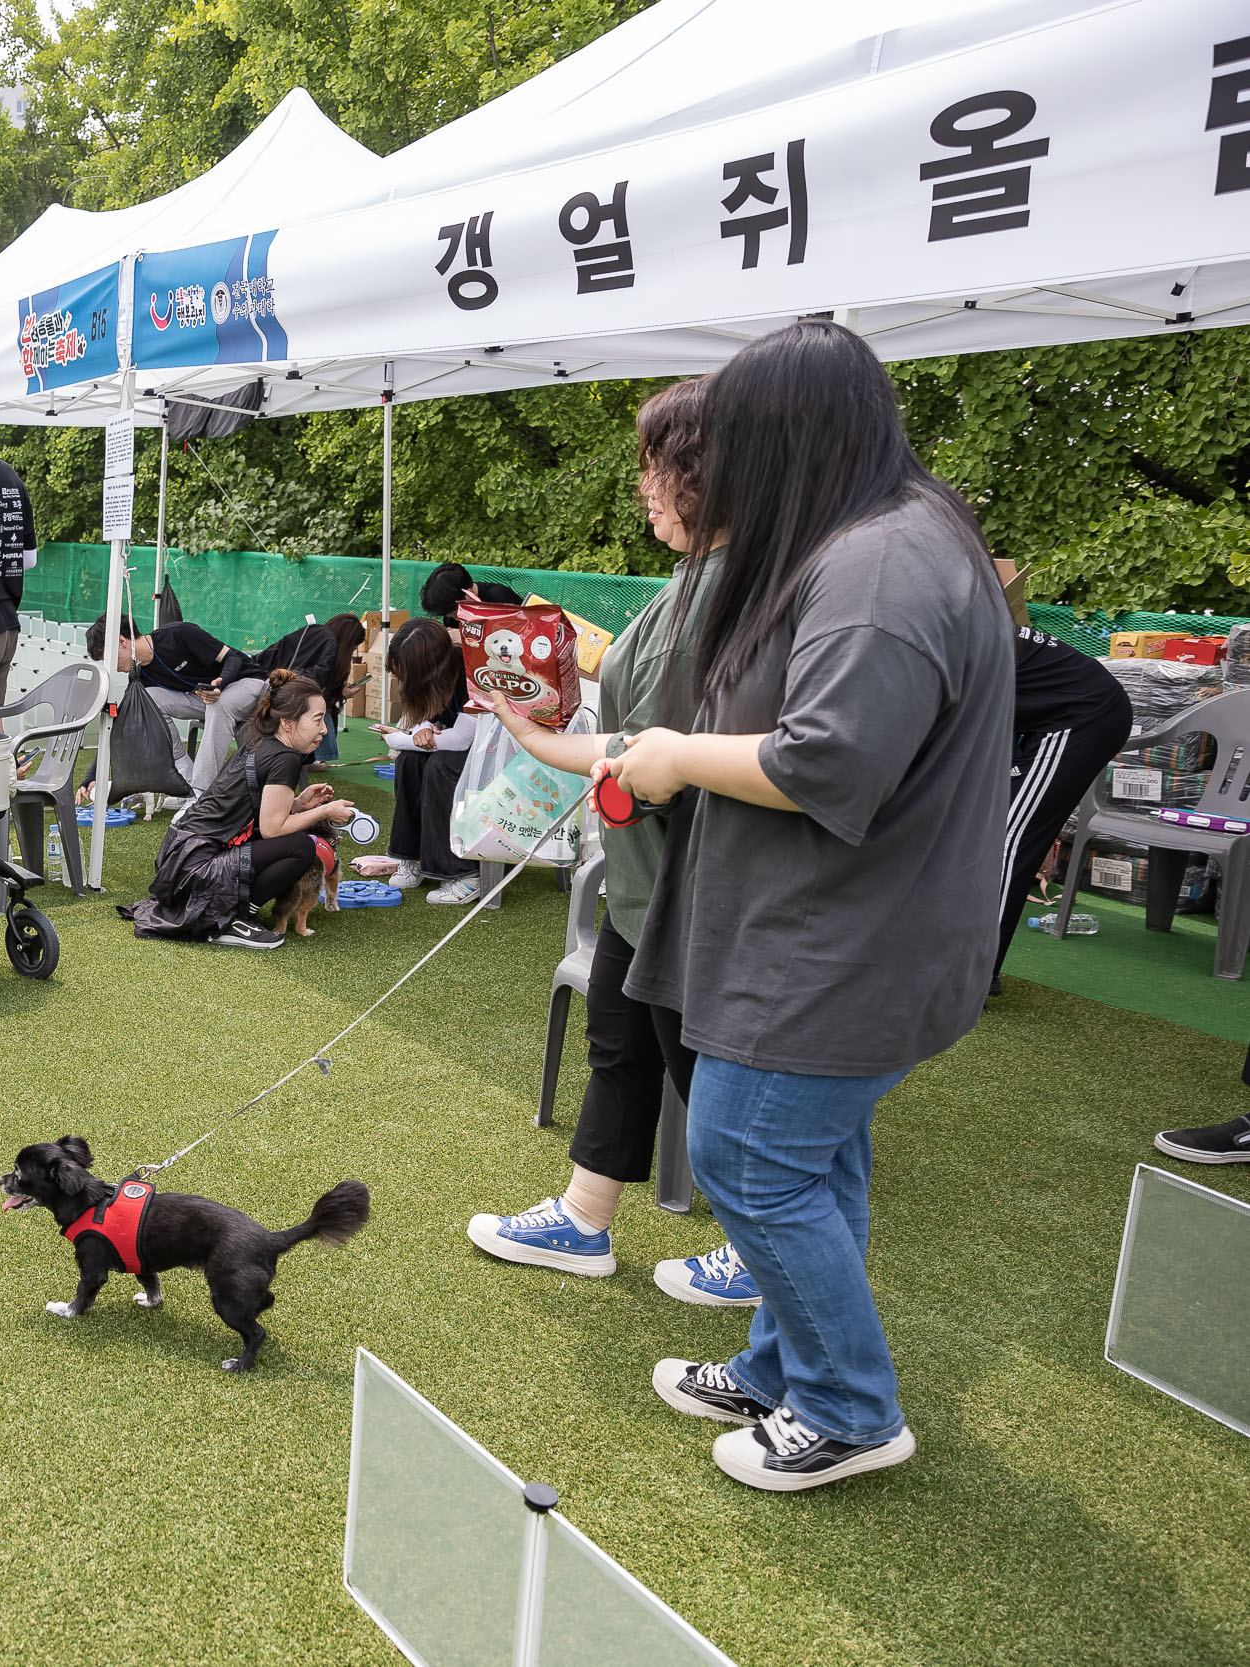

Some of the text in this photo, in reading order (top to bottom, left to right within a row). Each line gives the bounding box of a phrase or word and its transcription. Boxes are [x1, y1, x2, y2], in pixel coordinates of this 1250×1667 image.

[232, 296, 275, 320] 수의과대학
[21, 311, 63, 344] 반려동물과
[90, 308, 107, 341] B15
[480, 674, 537, 693] ALPO
[494, 671, 520, 681] PURINA
[497, 818, 517, 834] 가장
[517, 825, 543, 839] 맛있는
